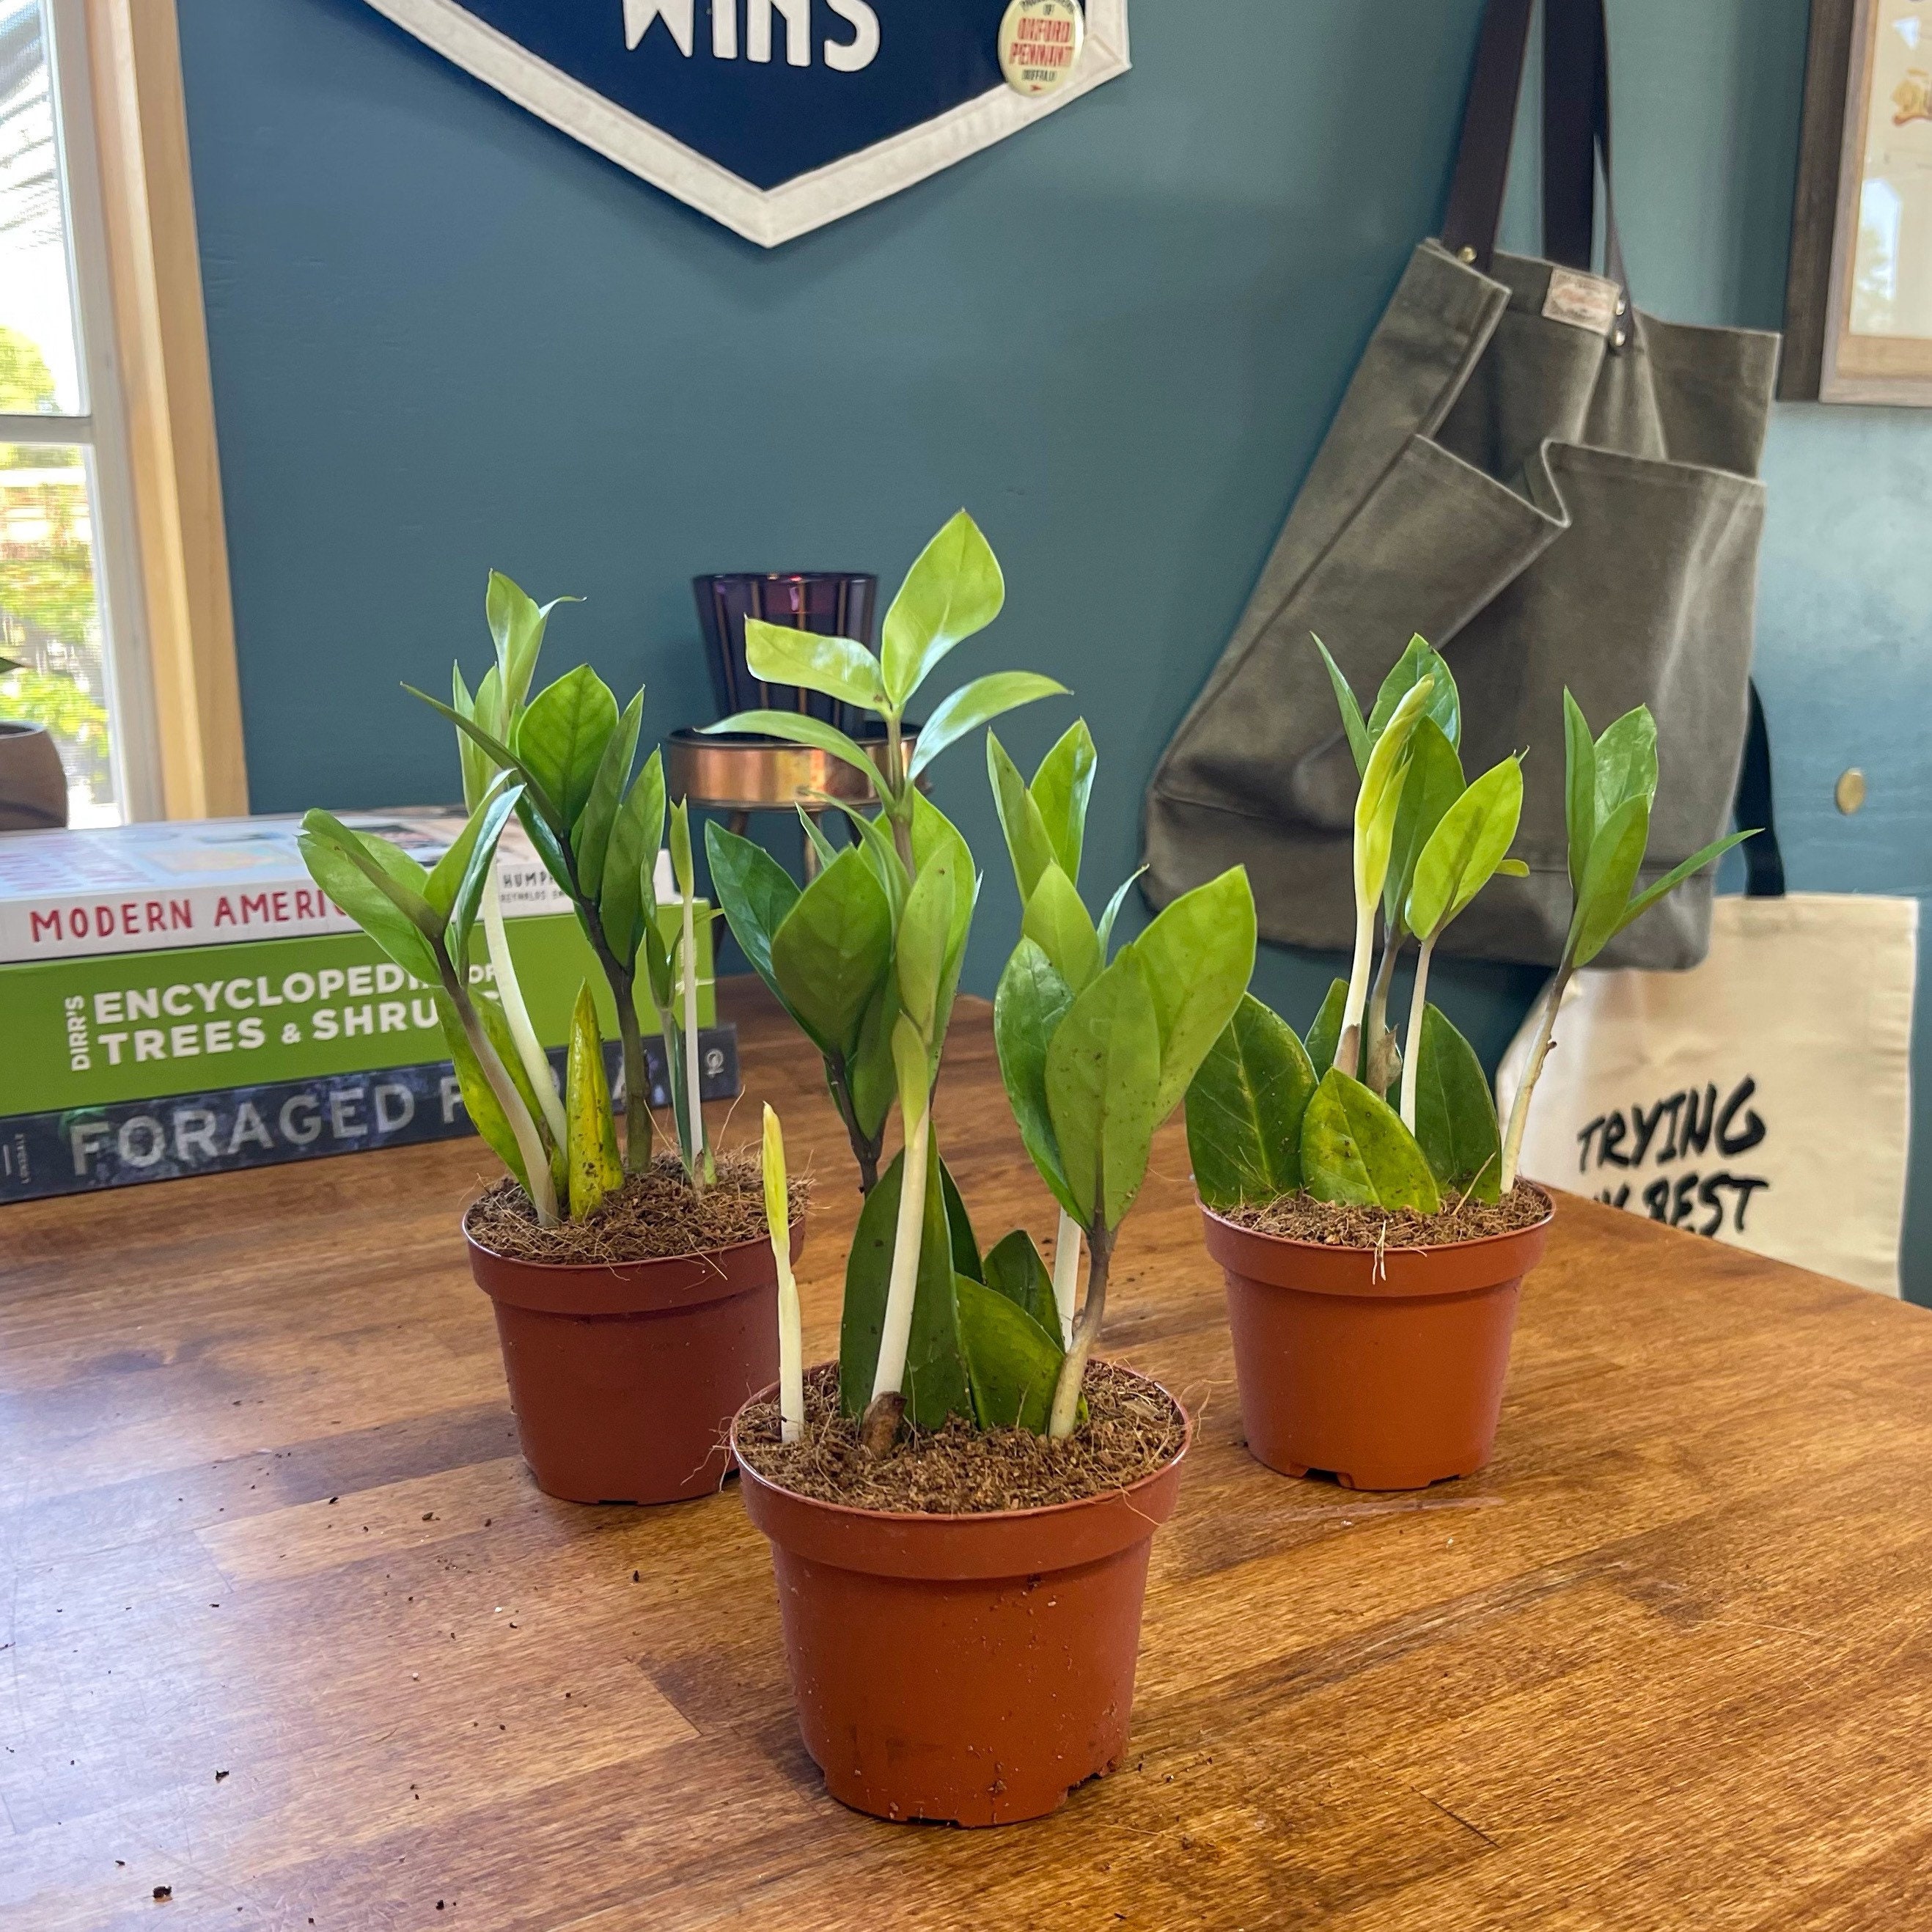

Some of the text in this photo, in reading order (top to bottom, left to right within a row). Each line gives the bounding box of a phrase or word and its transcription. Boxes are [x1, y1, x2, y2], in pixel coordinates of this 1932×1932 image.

[623, 0, 881, 72] WINS
[1009, 42, 1073, 67] PENNANT
[1018, 18, 1071, 43] OXFORD
[29, 898, 193, 943] MODERN
[65, 995, 91, 1072] DIRR'S
[98, 999, 440, 1065] TREES & SHRU
[70, 1083, 416, 1177] FORAGED
[1578, 1073, 1766, 1174] TRYING
[1642, 1170, 1769, 1238] BEST
